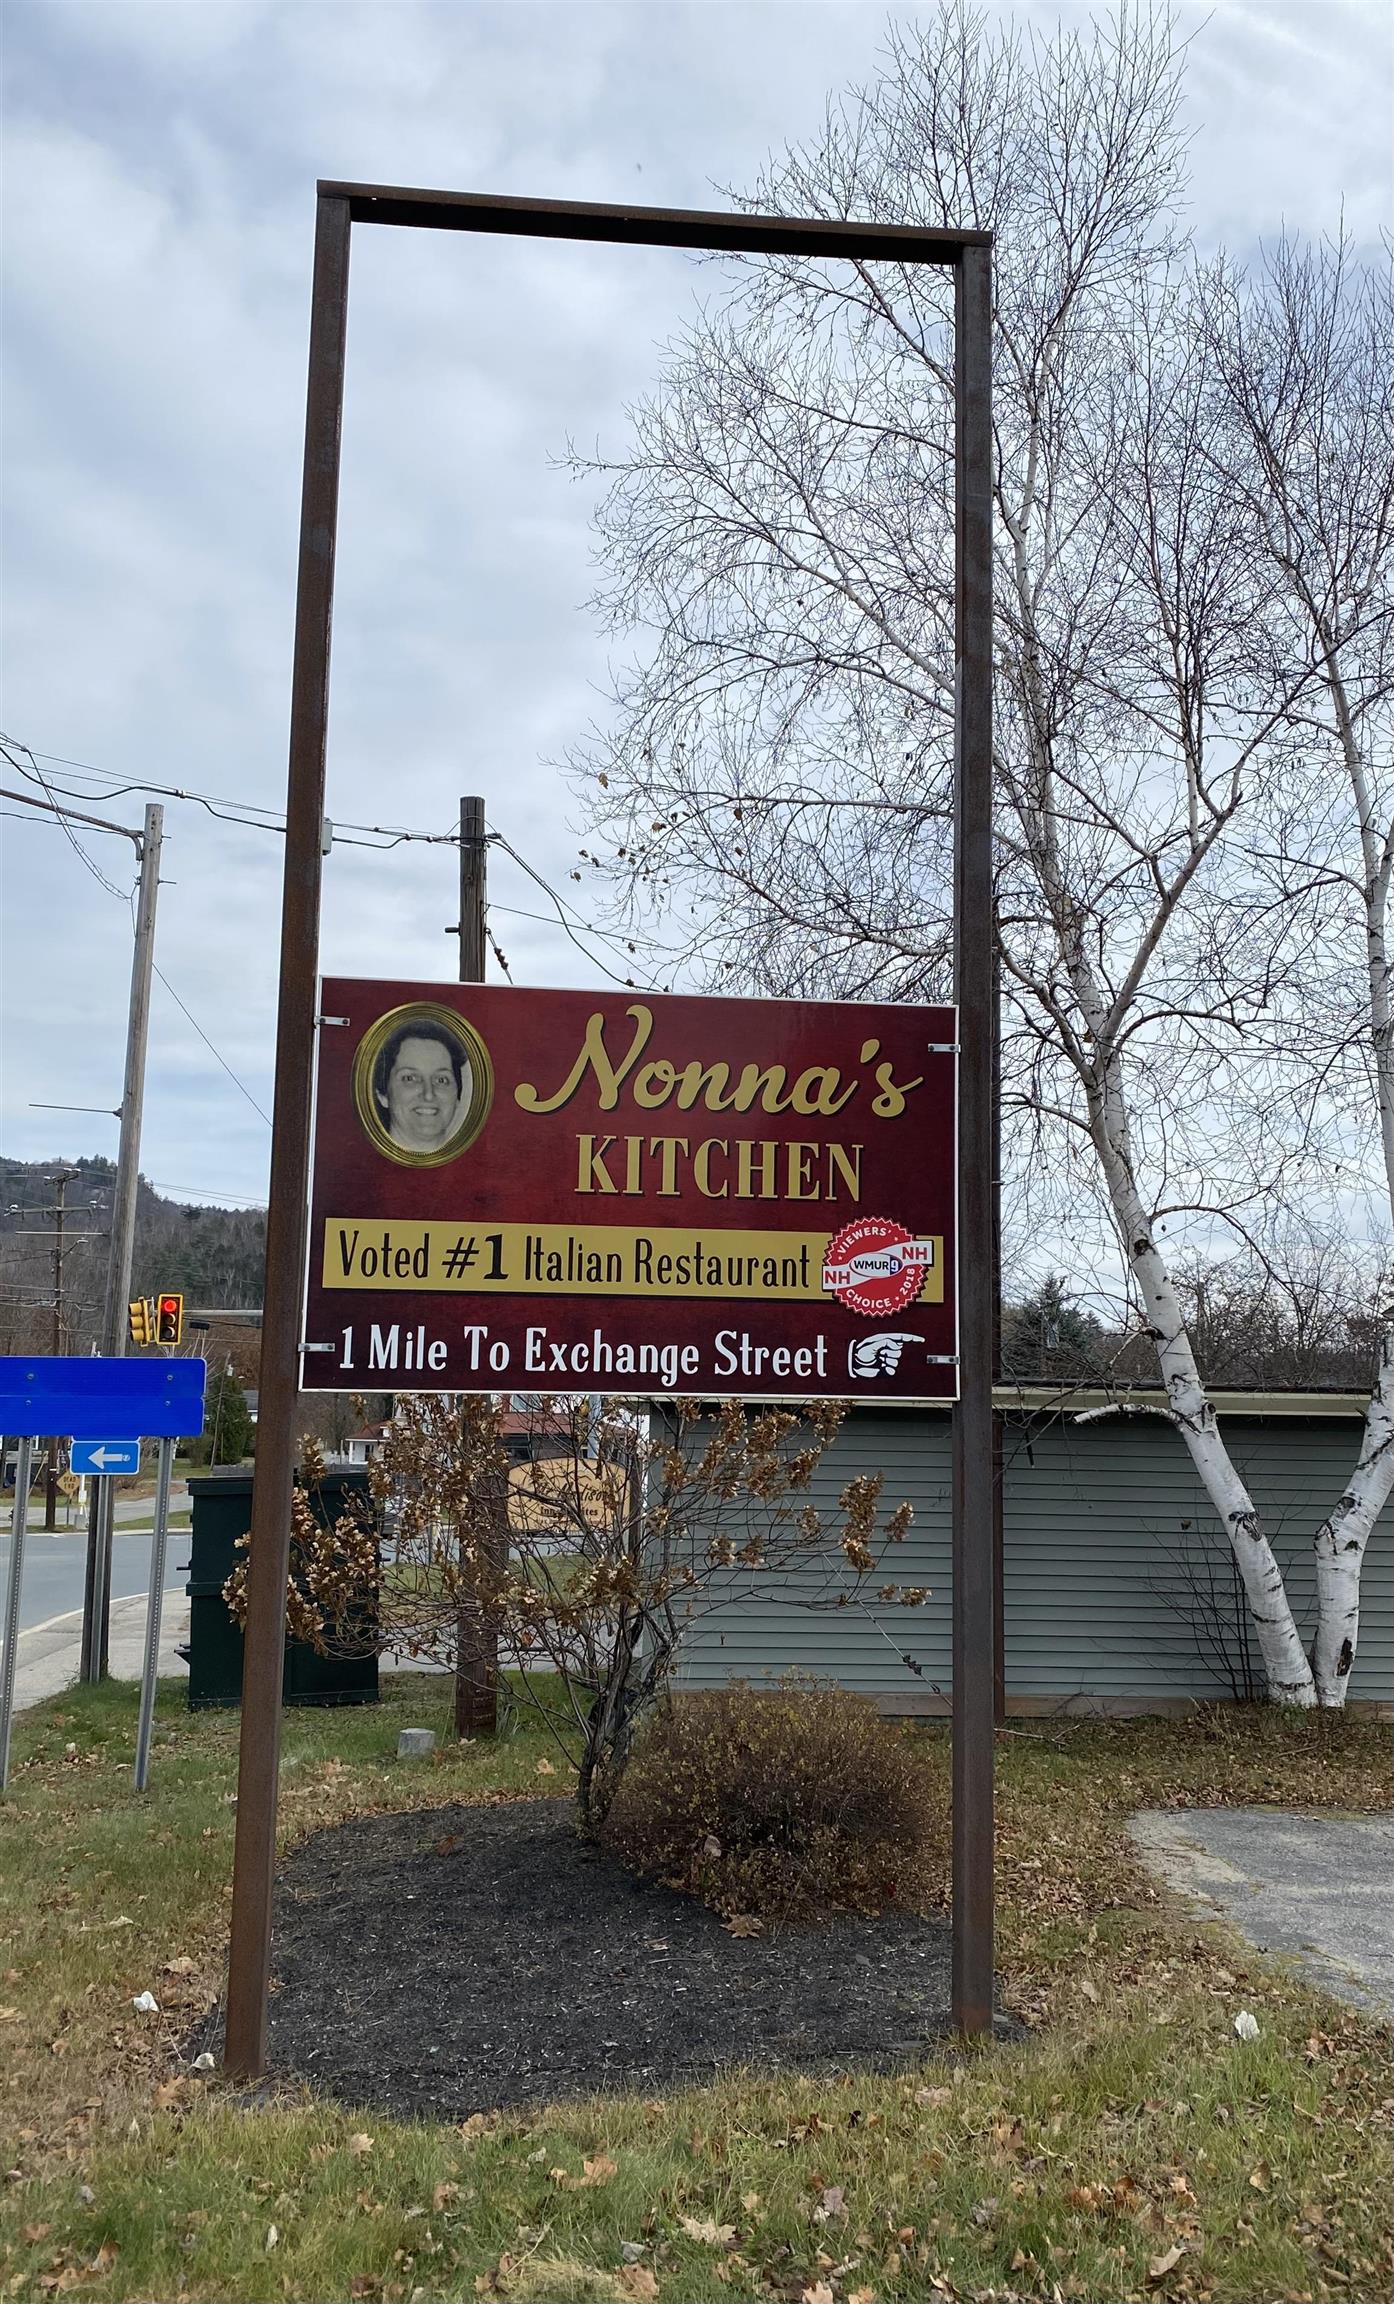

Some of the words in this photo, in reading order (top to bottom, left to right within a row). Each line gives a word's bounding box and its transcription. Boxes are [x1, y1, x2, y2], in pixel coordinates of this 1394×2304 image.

[514, 1004, 923, 1118] Nonna's
[574, 1134, 864, 1202] KITCHEN
[339, 1230, 430, 1279] Voted
[441, 1234, 509, 1280] #1
[525, 1235, 622, 1282] Italian
[634, 1238, 810, 1288] Restaurant
[824, 1270, 851, 1284] NH
[902, 1246, 928, 1260] NH
[846, 1288, 892, 1309] CHOICE
[900, 1267, 916, 1296] 2018
[339, 1325, 354, 1369] 1
[368, 1324, 448, 1370] Mile
[463, 1325, 510, 1371] To
[524, 1327, 700, 1387] Exchange
[714, 1330, 828, 1377] Street
